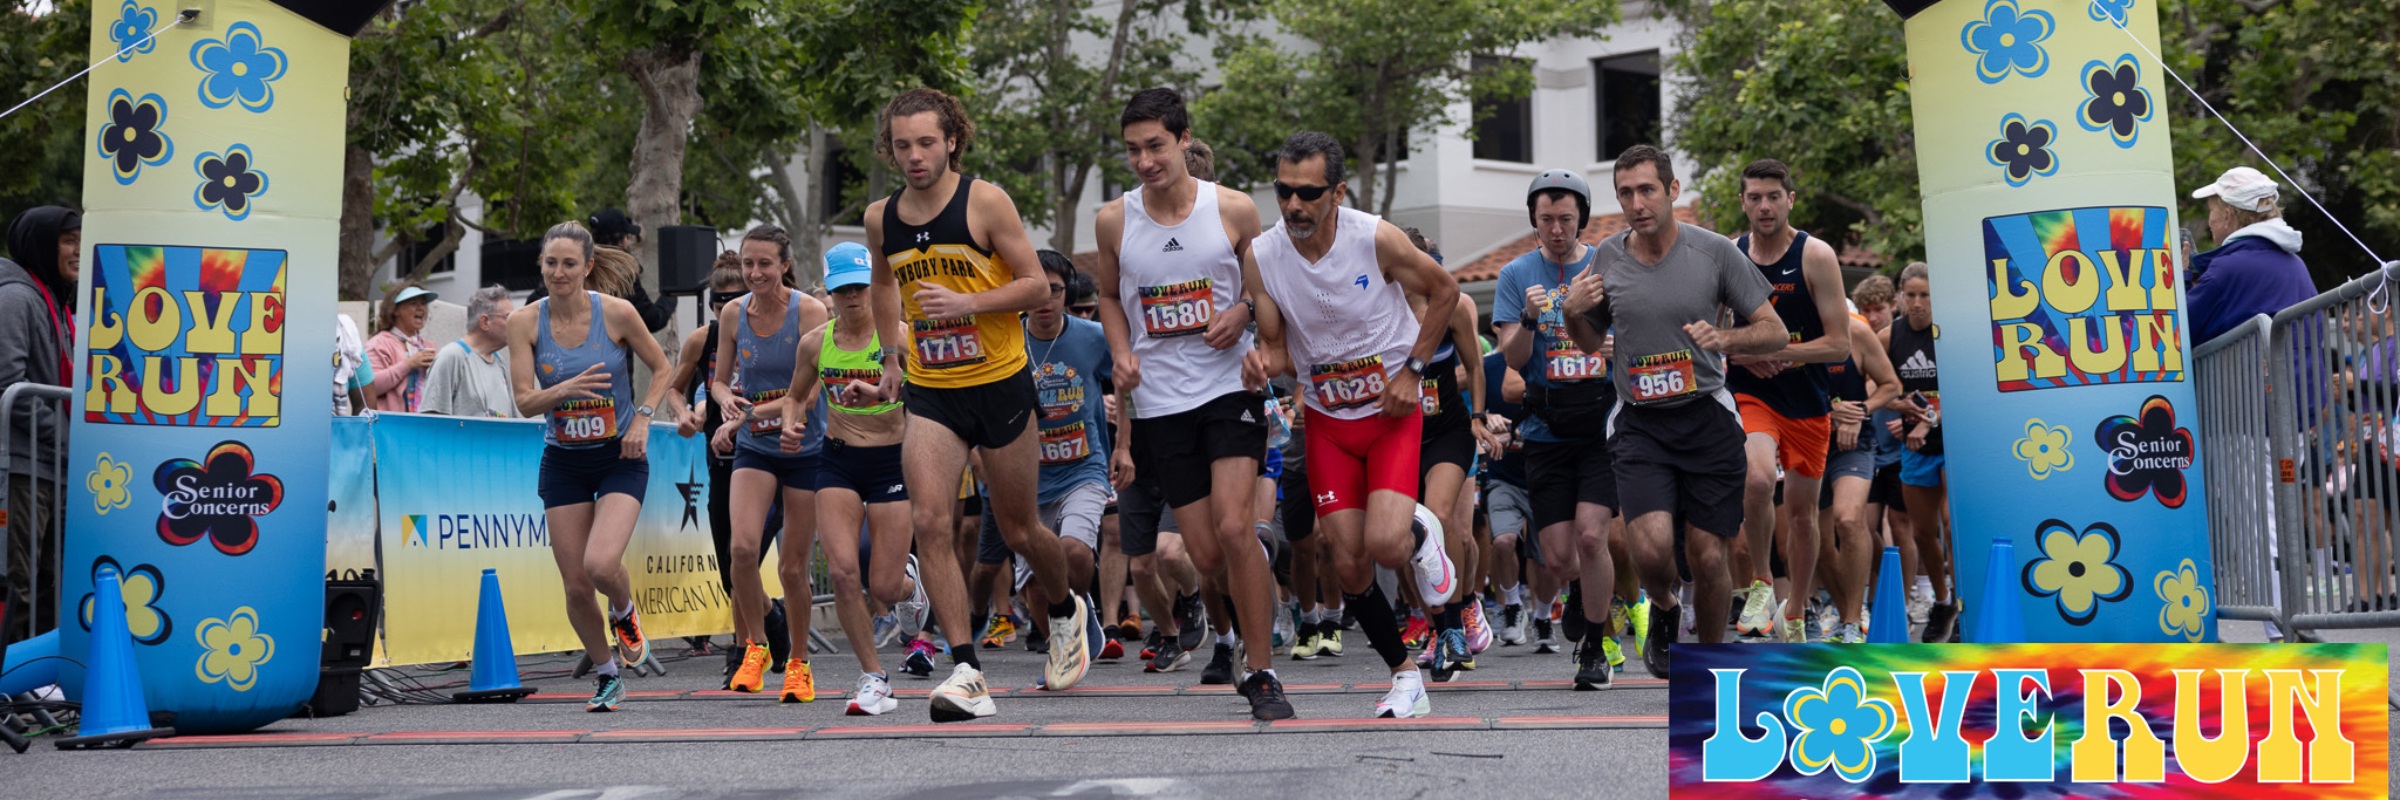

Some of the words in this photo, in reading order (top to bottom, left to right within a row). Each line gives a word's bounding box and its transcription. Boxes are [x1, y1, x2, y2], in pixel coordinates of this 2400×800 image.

[1162, 245, 1184, 253] adidas
[940, 257, 976, 279] PARK
[1991, 248, 2177, 321] LOVE
[88, 285, 284, 355] LOVE
[1146, 298, 1211, 330] 1580
[920, 334, 978, 362] 1715
[1996, 314, 2184, 382] RUN
[1550, 356, 1602, 377] 1612
[85, 354, 280, 417] RUN
[1320, 372, 1385, 403] 1628
[1639, 370, 1685, 397] 956
[564, 416, 606, 439] 409
[2116, 431, 2181, 460] Senior
[2107, 447, 2190, 476] Concerns
[175, 474, 259, 504] Senior
[162, 490, 270, 519] Concerns
[438, 513, 552, 549] PENNYM
